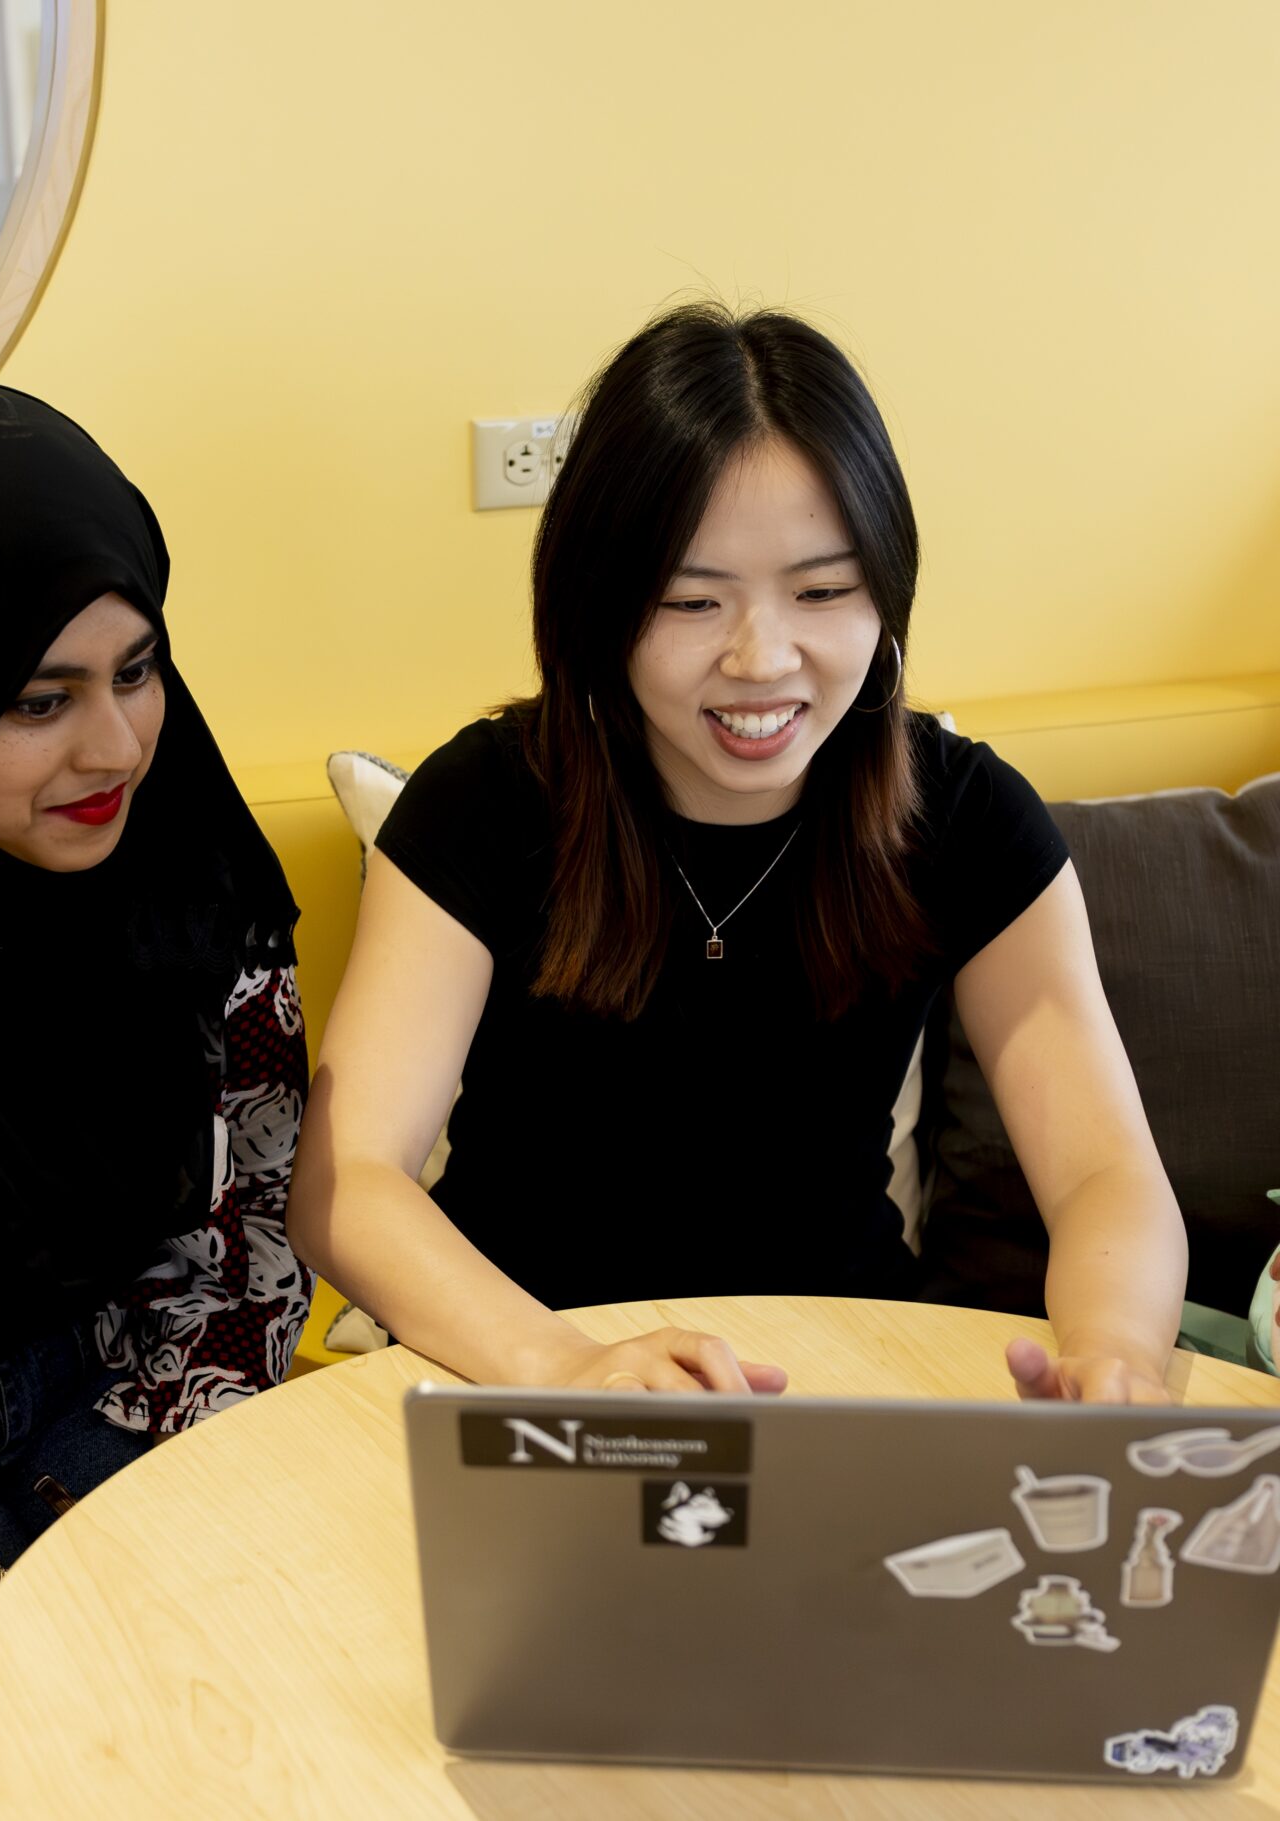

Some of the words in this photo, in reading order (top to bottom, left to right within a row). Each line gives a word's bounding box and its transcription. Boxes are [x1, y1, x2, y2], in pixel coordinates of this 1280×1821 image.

[504, 1418, 583, 1462] N
[583, 1434, 707, 1453] Northeastern
[583, 1448, 681, 1468] University
